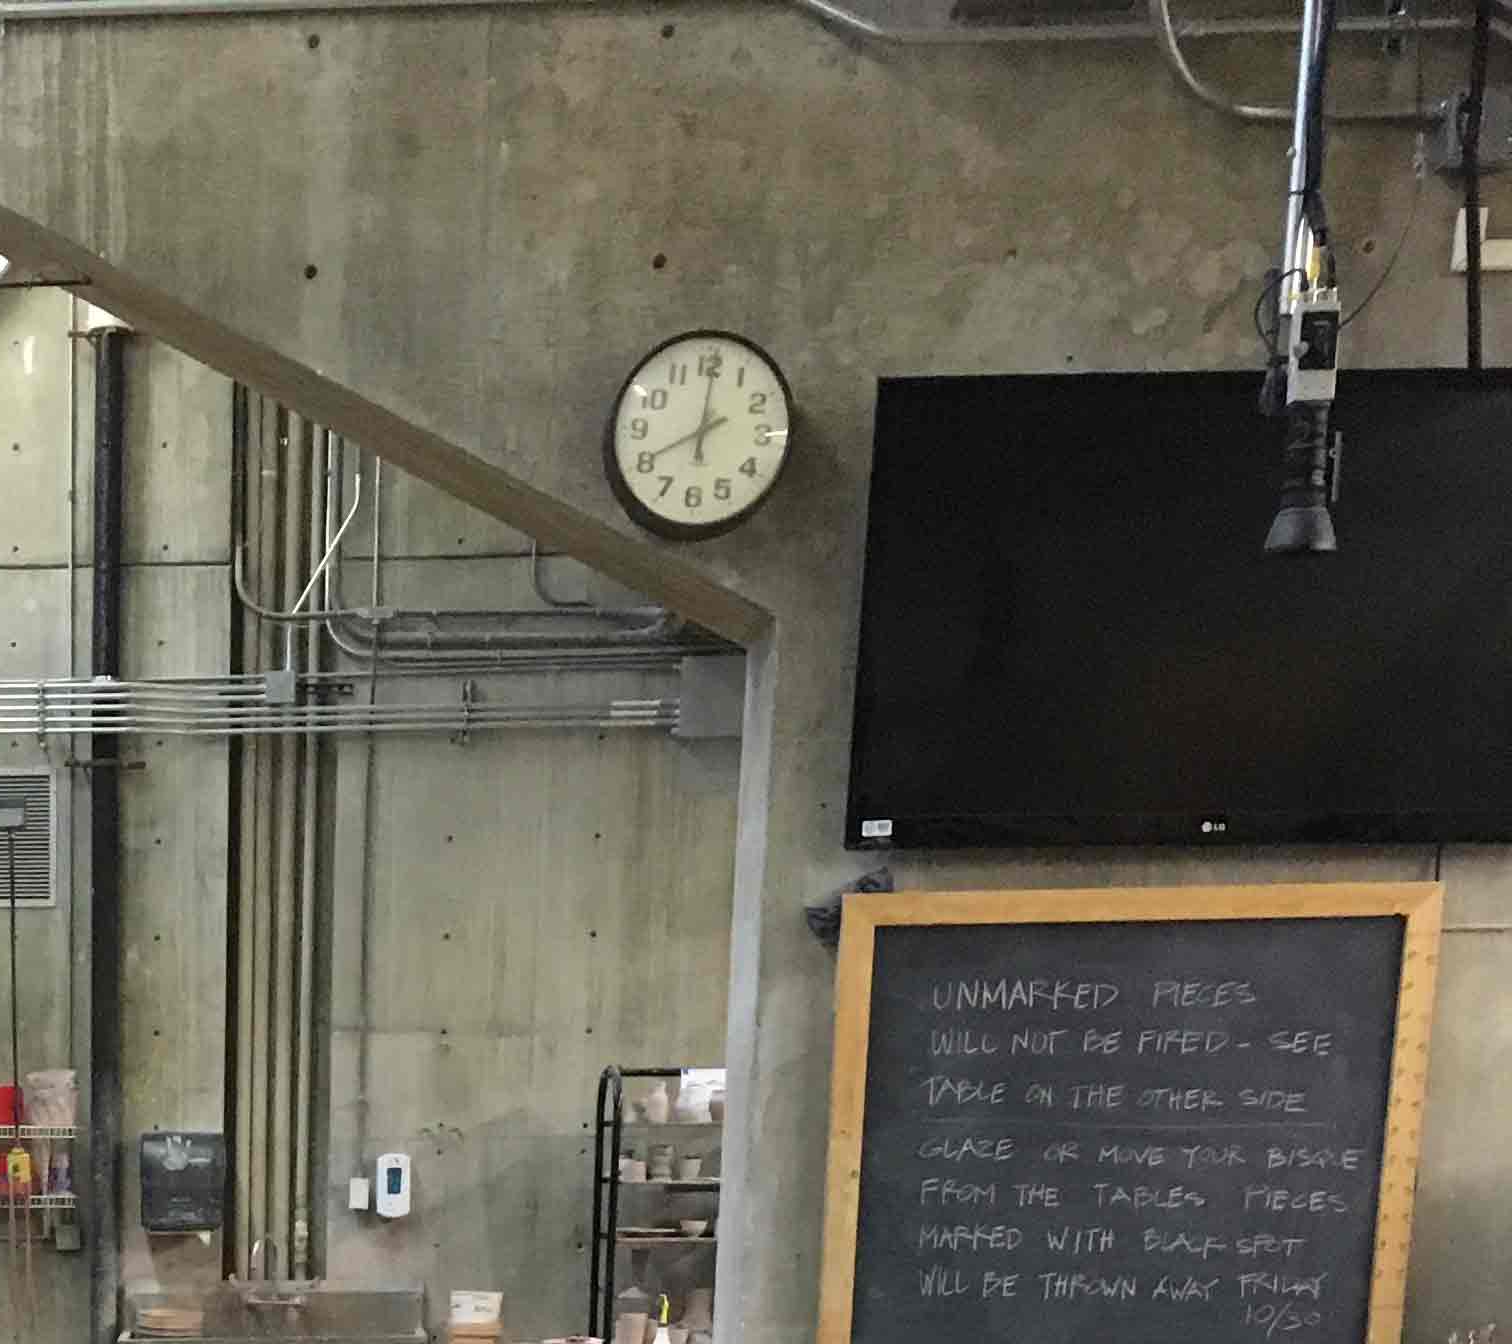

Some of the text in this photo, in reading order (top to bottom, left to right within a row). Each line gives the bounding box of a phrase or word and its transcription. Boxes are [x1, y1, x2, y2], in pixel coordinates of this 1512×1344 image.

[669, 364, 687, 386] 11
[736, 367, 745, 388] 1
[748, 393, 767, 414] 2
[631, 418, 649, 440] 9
[754, 424, 772, 446] 3
[636, 451, 655, 473] 8
[739, 457, 757, 477] 4
[658, 475, 675, 497] 7
[684, 486, 702, 508] 6
[713, 478, 732, 500] 5
[933, 978, 1256, 1010] UNMARKED PIECES
[930, 1028, 998, 1056] WILL
[1011, 1027, 1068, 1055] NOT
[1082, 1028, 1122, 1053] BE
[1138, 1030, 1230, 1056] FIRED
[1268, 1031, 1332, 1056] SEE
[920, 1075, 1307, 1112] TABLE ON THE OTHER SIDE
[919, 1138, 1015, 1161] GLAZE
[1043, 1141, 1080, 1163] OR
[1097, 1144, 1165, 1167] MOVE
[1181, 1144, 1246, 1168] YOUR
[920, 1178, 1346, 1212] FROM THE TABLES PIECES
[919, 1223, 1023, 1250] MARKED
[1047, 1226, 1115, 1254] WITH
[1236, 1234, 1307, 1258] SPOT
[919, 1263, 969, 1297] WILL
[983, 1271, 1020, 1298] BE
[1039, 1271, 1136, 1300] THROWN
[1152, 1276, 1220, 1301] AWAY
